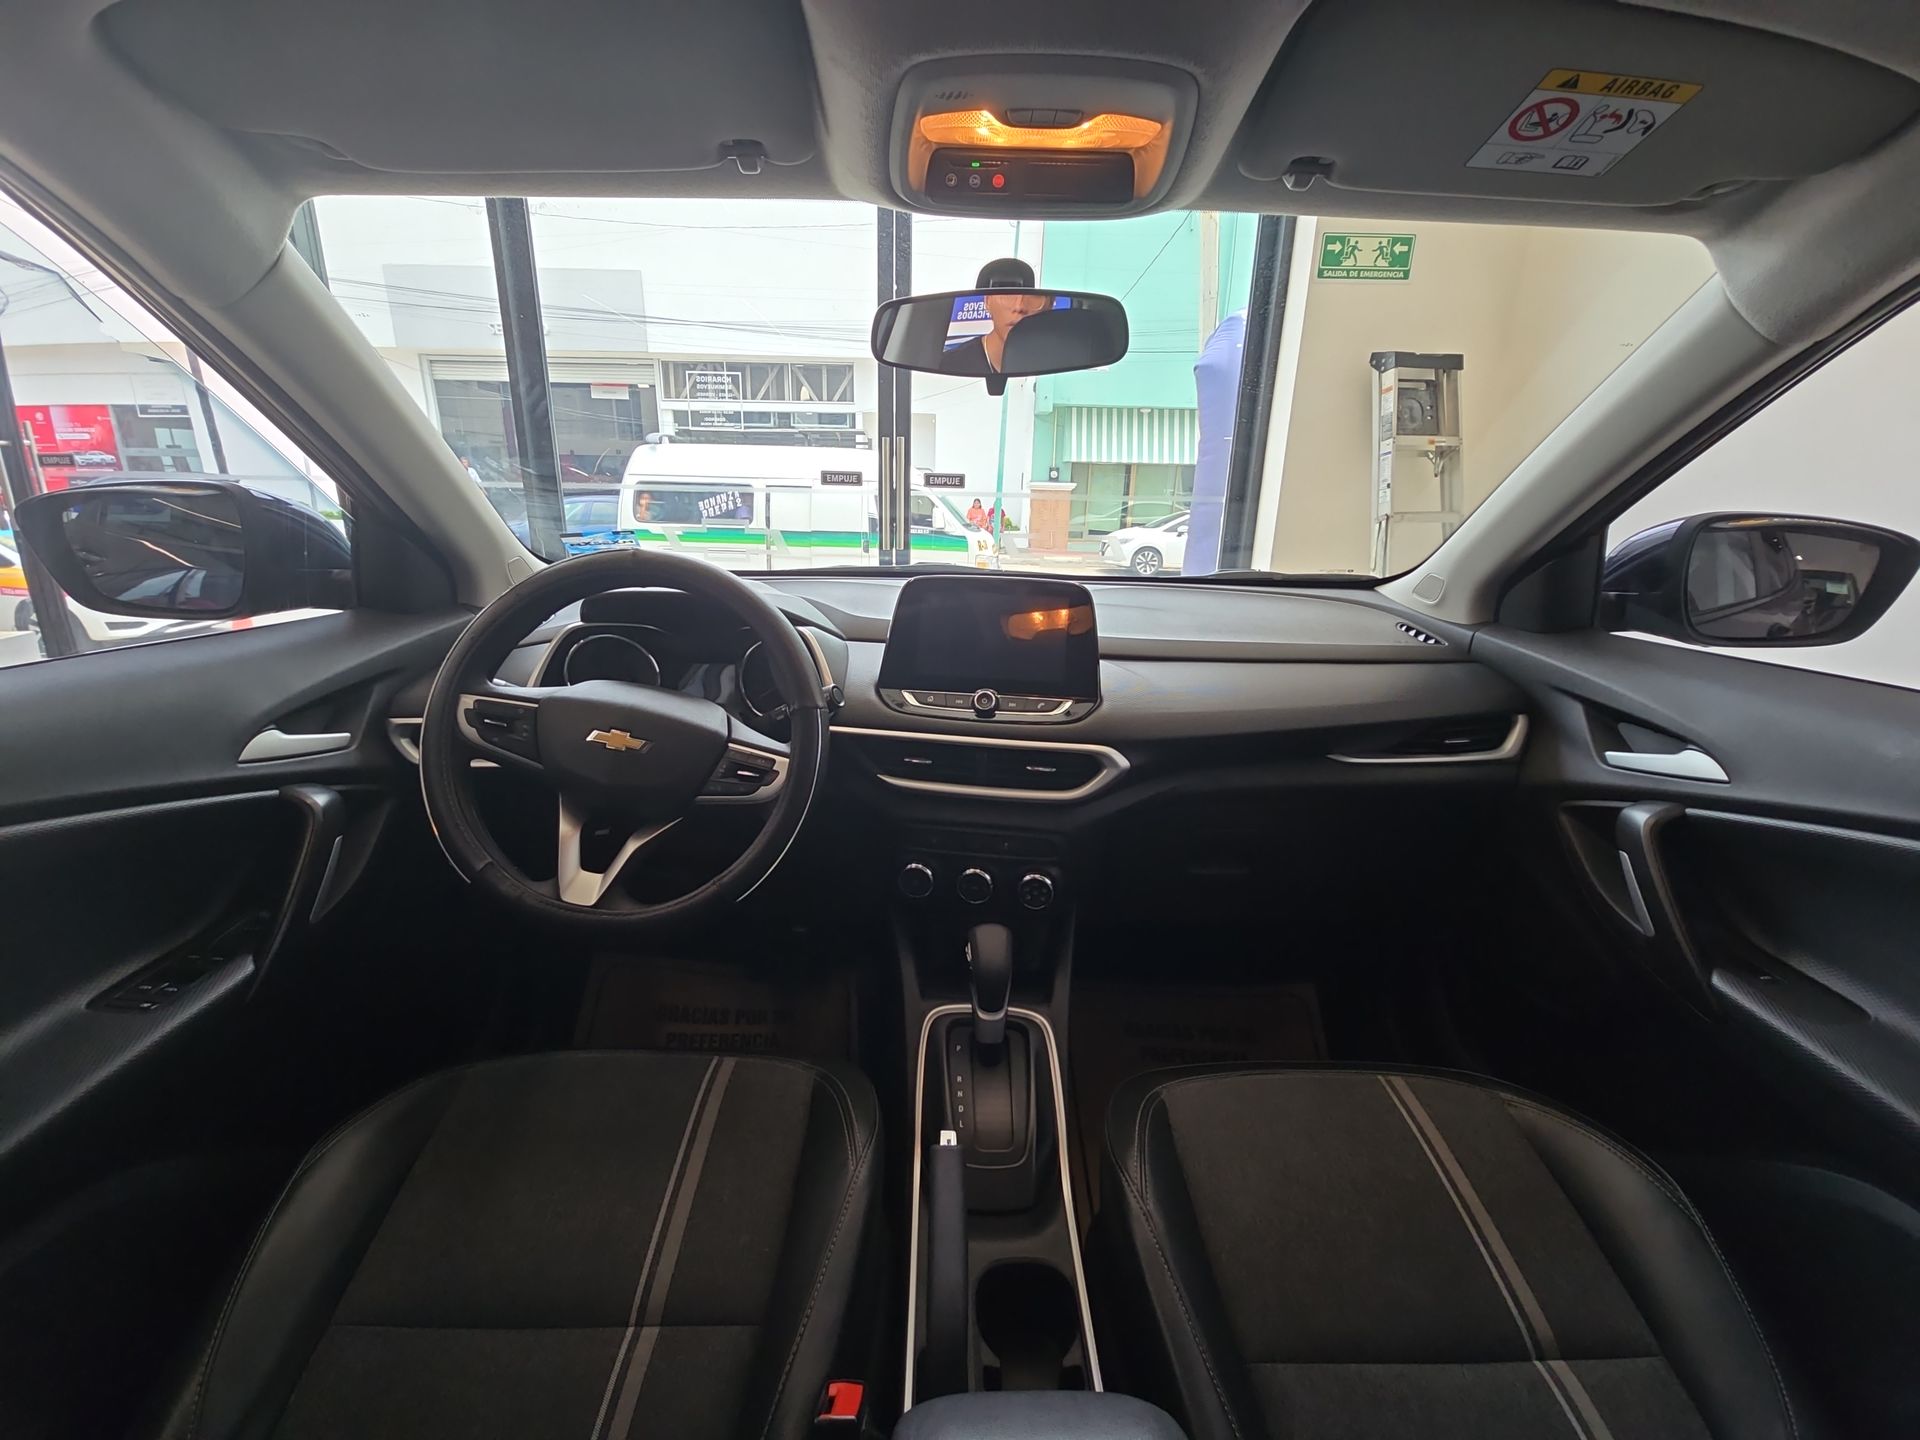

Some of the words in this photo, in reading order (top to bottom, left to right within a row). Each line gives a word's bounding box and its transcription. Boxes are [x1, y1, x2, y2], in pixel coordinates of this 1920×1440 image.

[1600, 78, 1681, 99] AIRBAG
[826, 474, 859, 484] EMPUJE
[929, 476, 961, 485] EMPUJE
[698, 491, 740, 511] BONANZA
[702, 500, 734, 519] PREPA
[657, 1003, 731, 1026] GRACIAS
[735, 1008, 769, 1025] POR
[665, 1031, 782, 1049] PREFERENCIA
